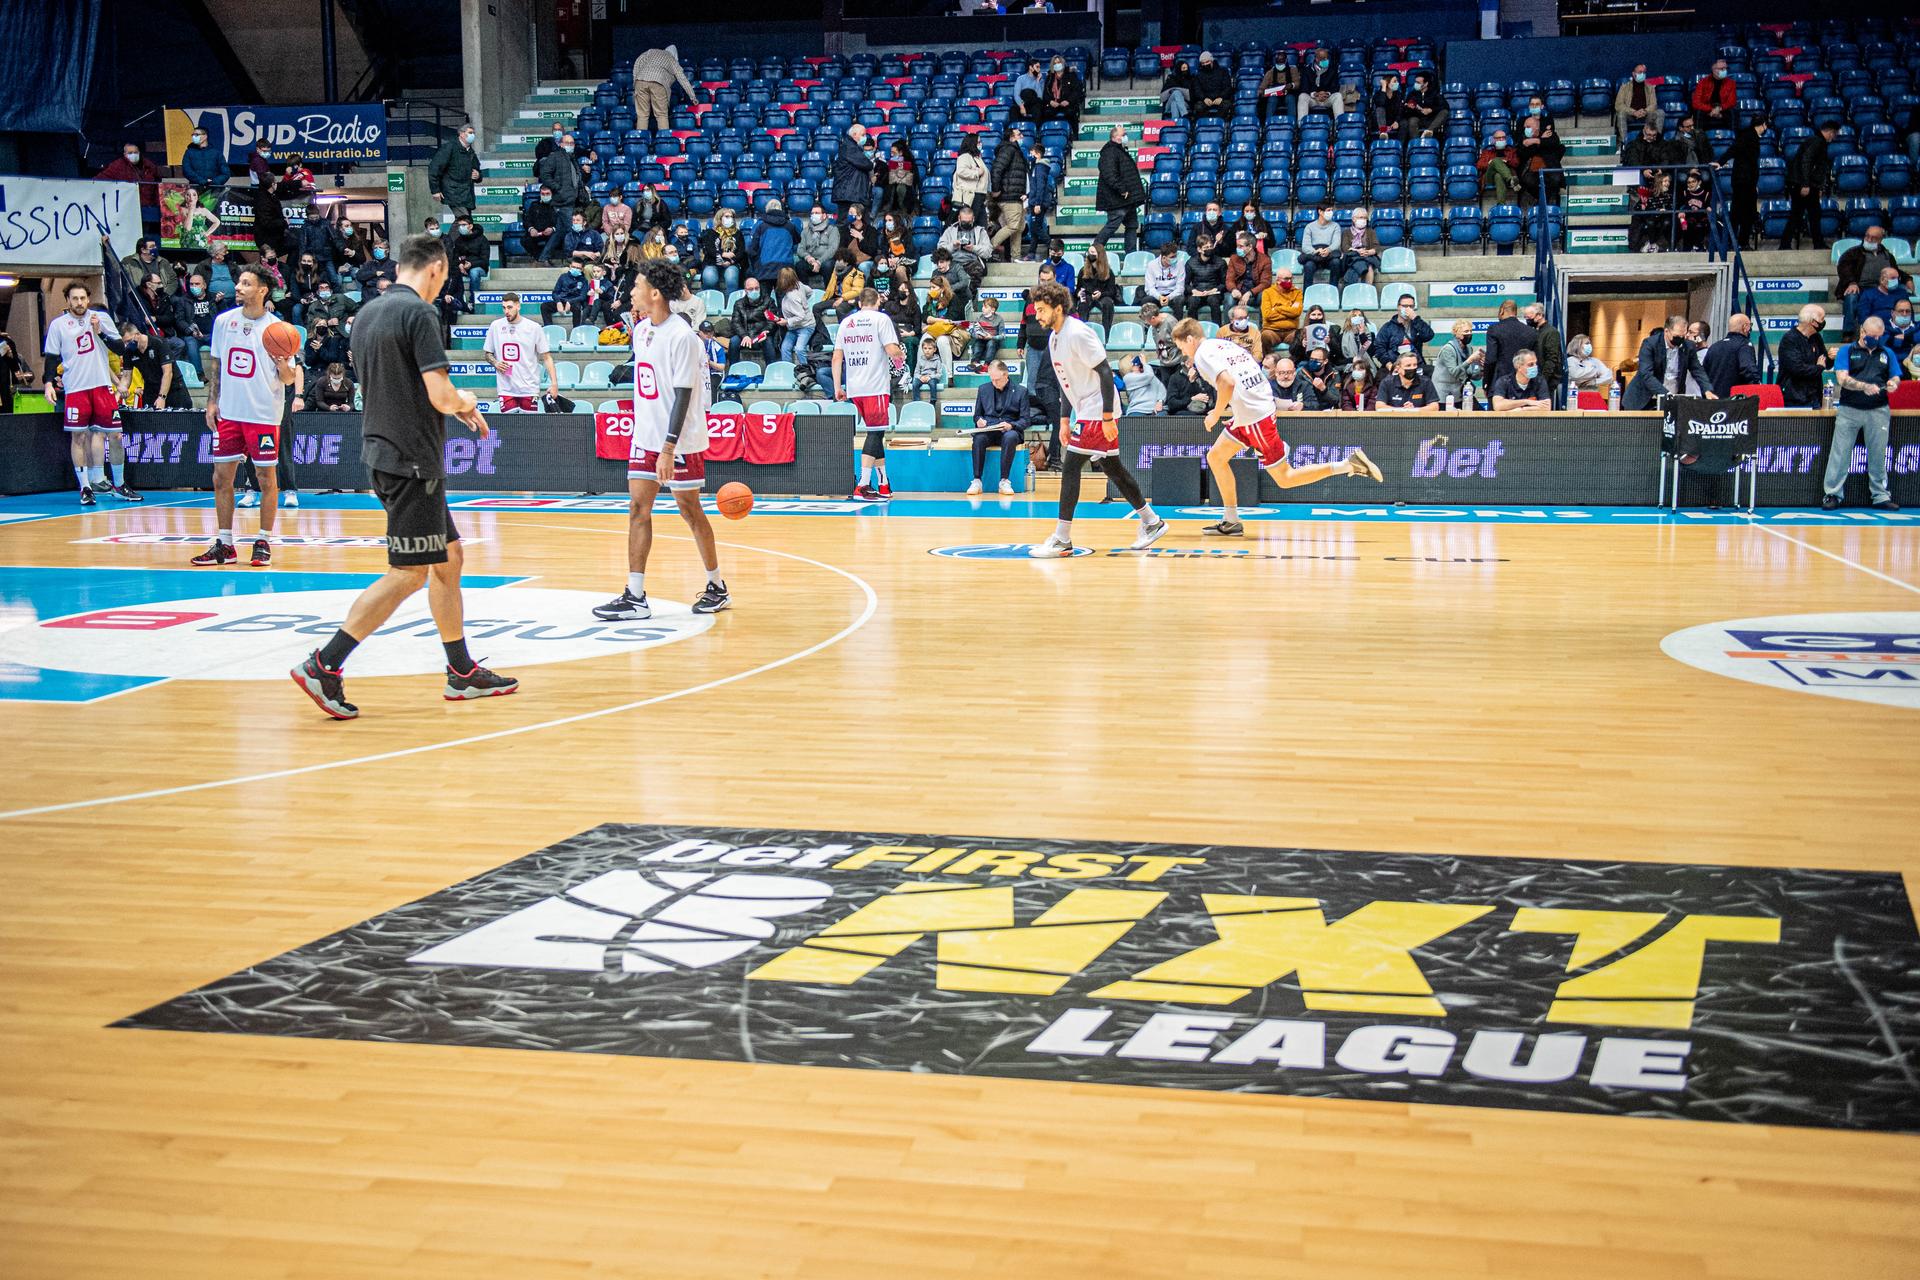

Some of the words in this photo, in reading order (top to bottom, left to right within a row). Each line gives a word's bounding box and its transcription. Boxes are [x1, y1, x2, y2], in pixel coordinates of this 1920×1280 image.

[298, 114, 381, 144] Radio
[606, 416, 634, 437] 29
[707, 418, 736, 438] 22
[762, 415, 777, 434] 5
[1688, 419, 1749, 435] SPALDING
[444, 429, 501, 475] et
[1411, 437, 1504, 478] bet
[1311, 508, 1593, 519] MONS
[638, 838, 1207, 882] betFIRST
[1027, 1007, 1693, 1092] LEAGUE
